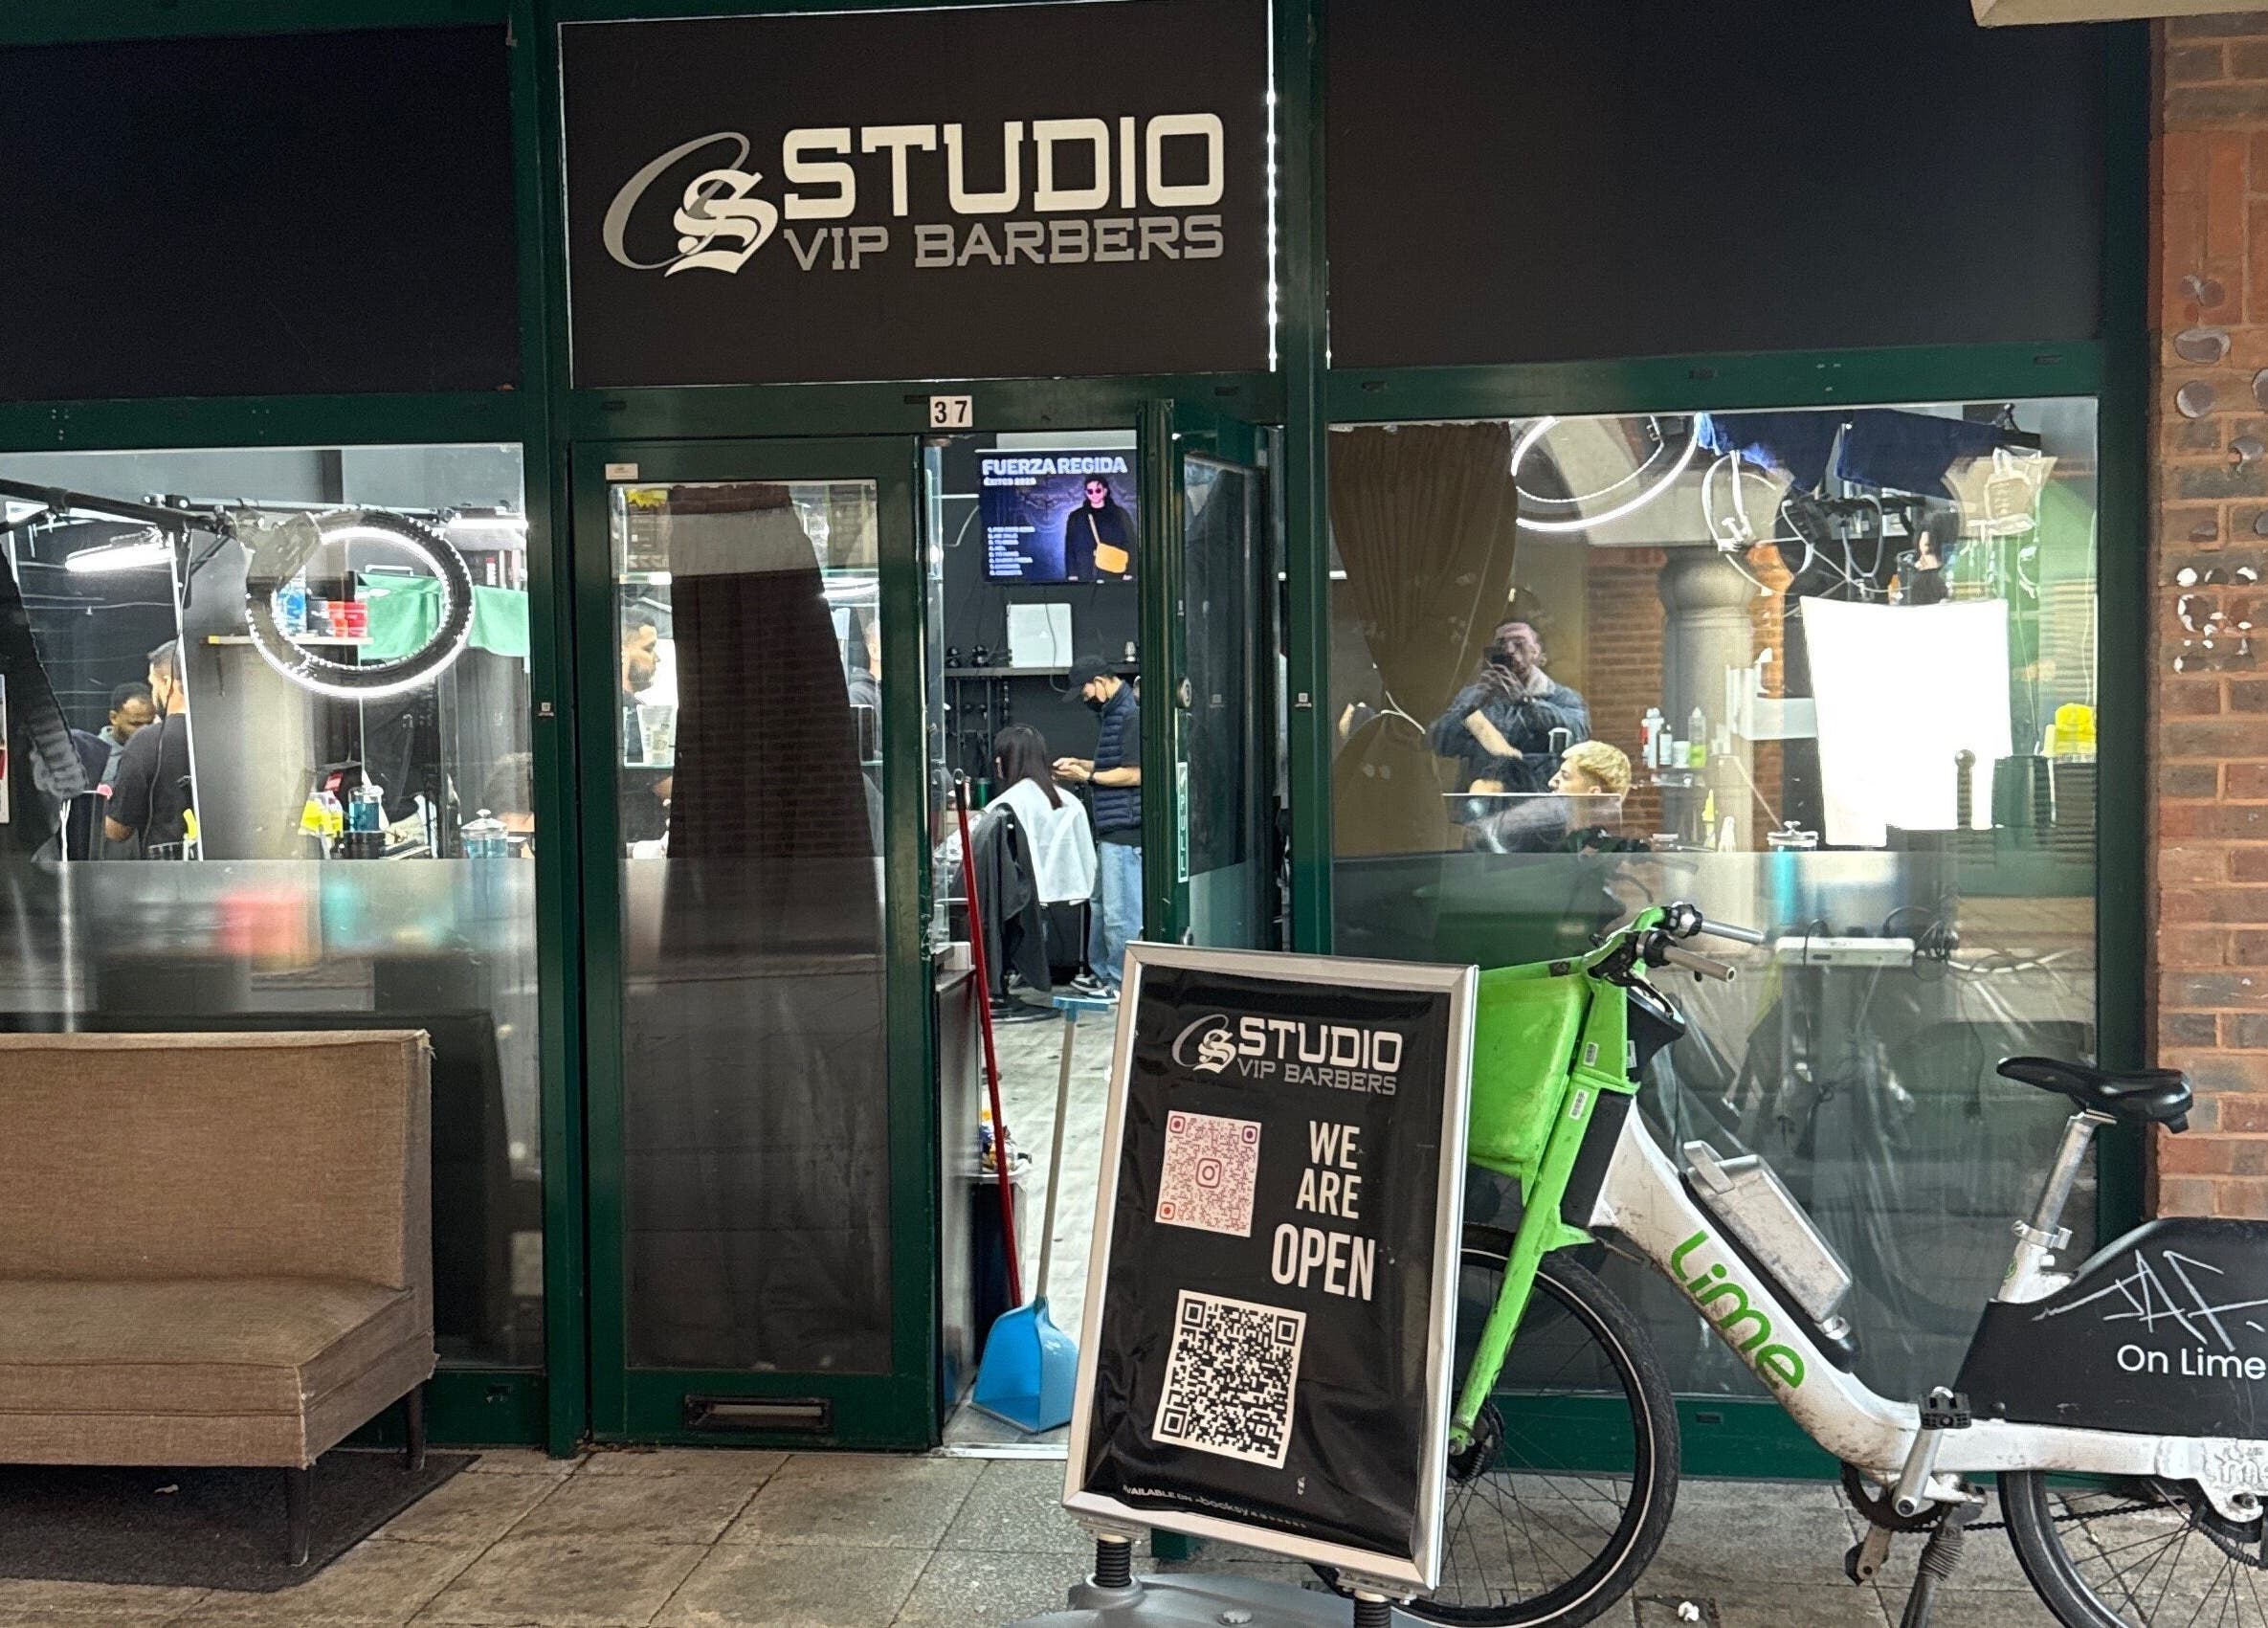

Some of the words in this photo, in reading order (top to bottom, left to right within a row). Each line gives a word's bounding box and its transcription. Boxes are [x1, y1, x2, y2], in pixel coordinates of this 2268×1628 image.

[782, 113, 1225, 221] STUDIO
[784, 226, 889, 272] VIP
[914, 214, 1224, 269] BARBERS
[934, 400, 969, 425] 37
[982, 457, 1056, 476] FUERZA
[1057, 457, 1128, 474] REGIDA
[1238, 1016, 1403, 1073] STUDIO
[1237, 1058, 1277, 1080] VIP
[1284, 1063, 1397, 1096] BARBERS
[1309, 1120, 1361, 1171] WE
[1296, 1169, 1363, 1220] ARE
[1271, 1223, 1376, 1302] OPEN
[1670, 1230, 1806, 1390] Lime
[2117, 1345, 2168, 1374] On
[2181, 1347, 2267, 1380] Lime
